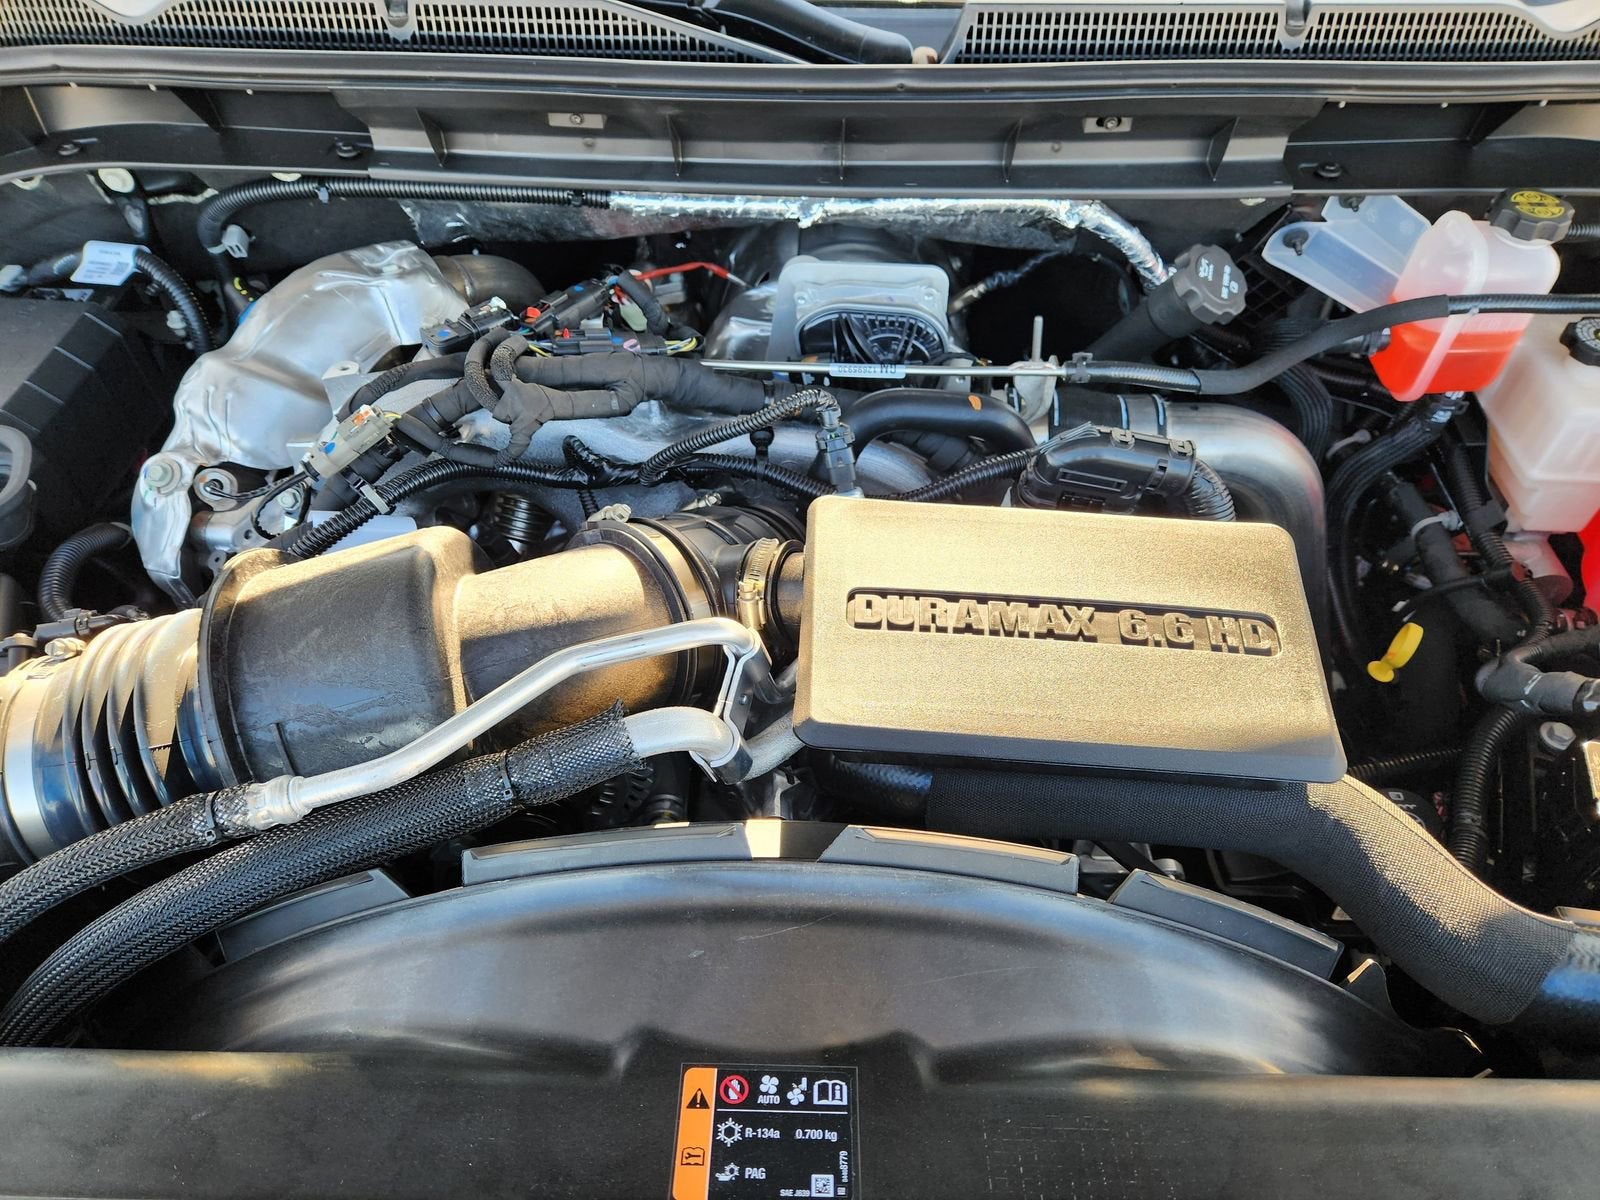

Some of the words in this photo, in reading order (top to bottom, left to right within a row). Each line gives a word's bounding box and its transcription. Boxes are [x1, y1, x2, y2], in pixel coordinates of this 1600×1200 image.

[880, 363, 897, 374] GM
[852, 593, 1097, 639] DURAMAX
[1117, 609, 1195, 647] 6.6
[1204, 614, 1273, 653] HD
[757, 1094, 781, 1105] AUTO
[744, 1127, 781, 1139] R-134a
[795, 1128, 823, 1140] 0.700
[824, 1129, 838, 1142] kg
[744, 1167, 766, 1180] PAG
[779, 1188, 794, 1197] SAE
